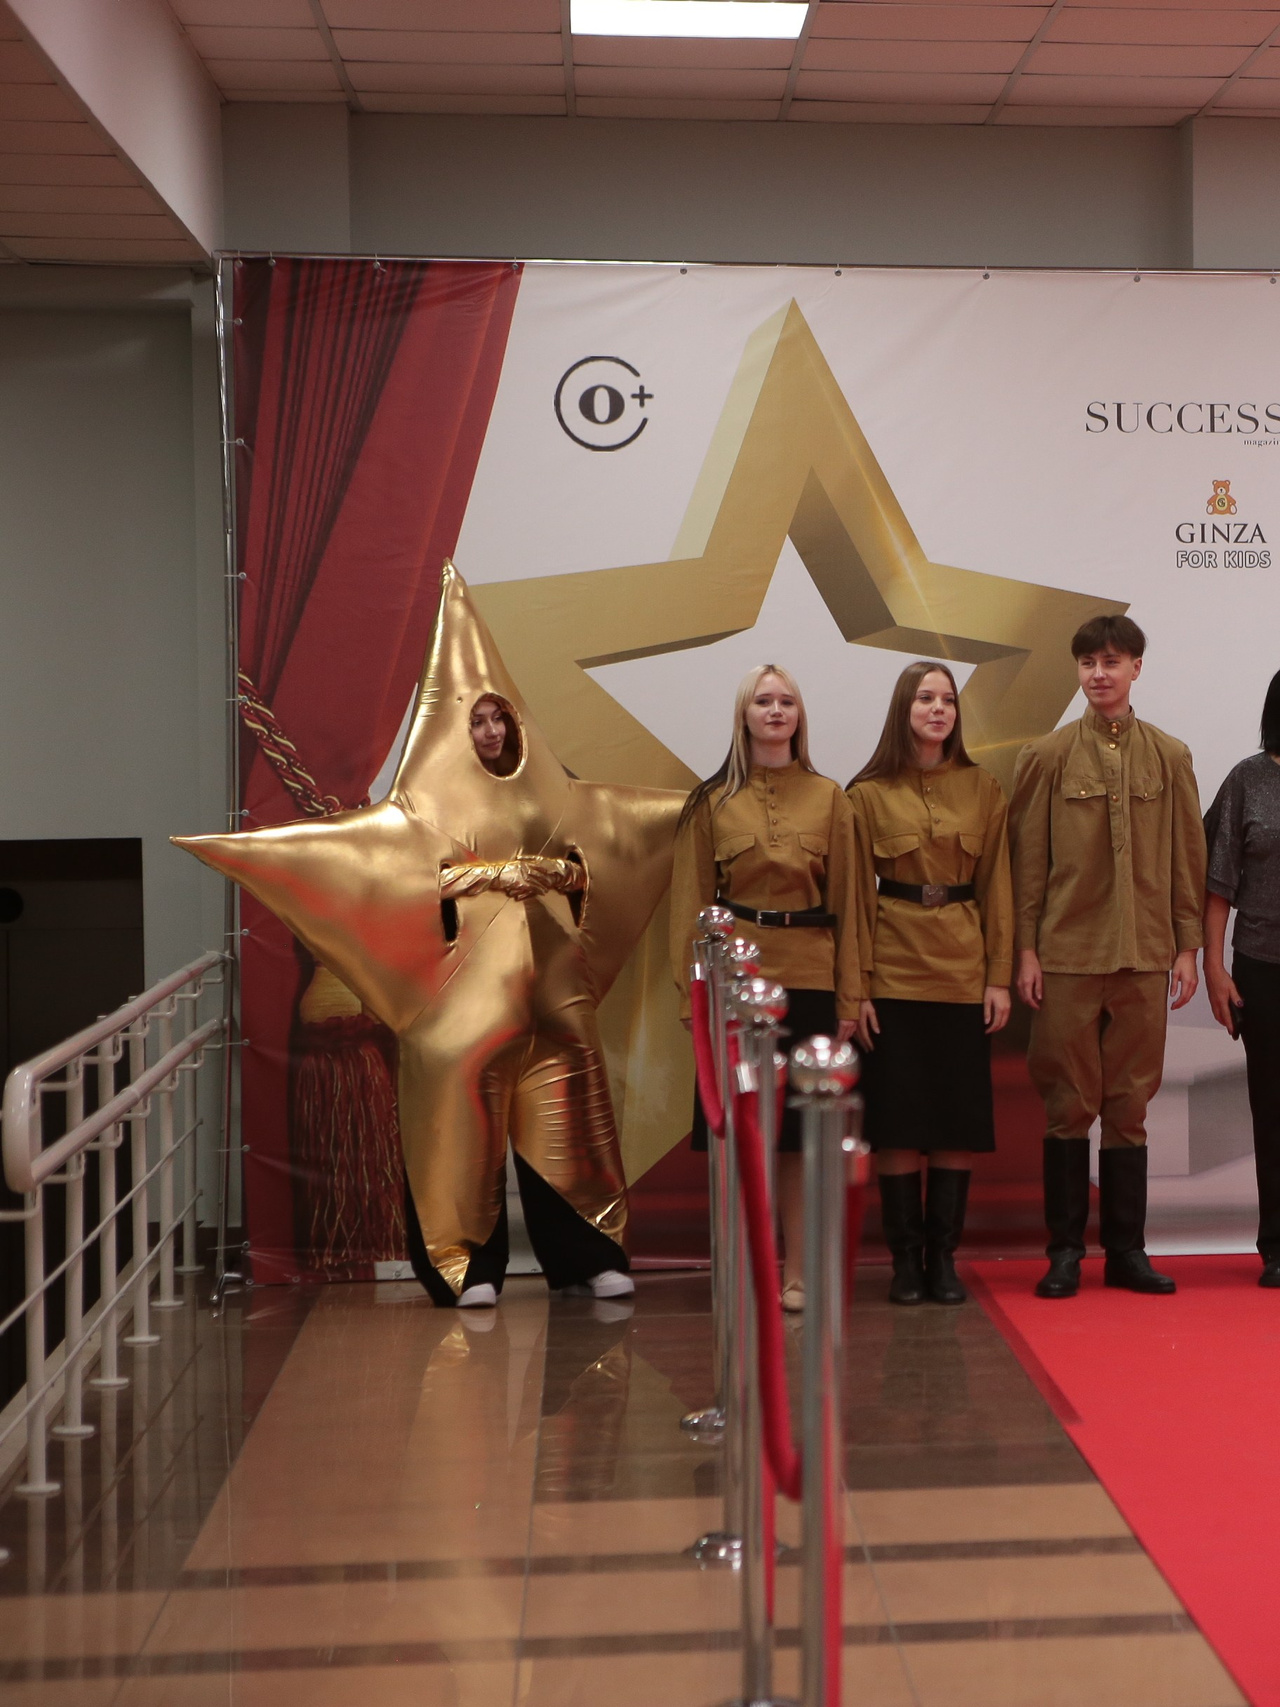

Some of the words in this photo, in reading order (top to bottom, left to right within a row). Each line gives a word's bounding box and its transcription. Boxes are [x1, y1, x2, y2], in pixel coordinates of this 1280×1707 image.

[1175, 522, 1267, 544] GINZA
[1176, 550, 1218, 569] FOR
[1223, 550, 1272, 569] KIDS
